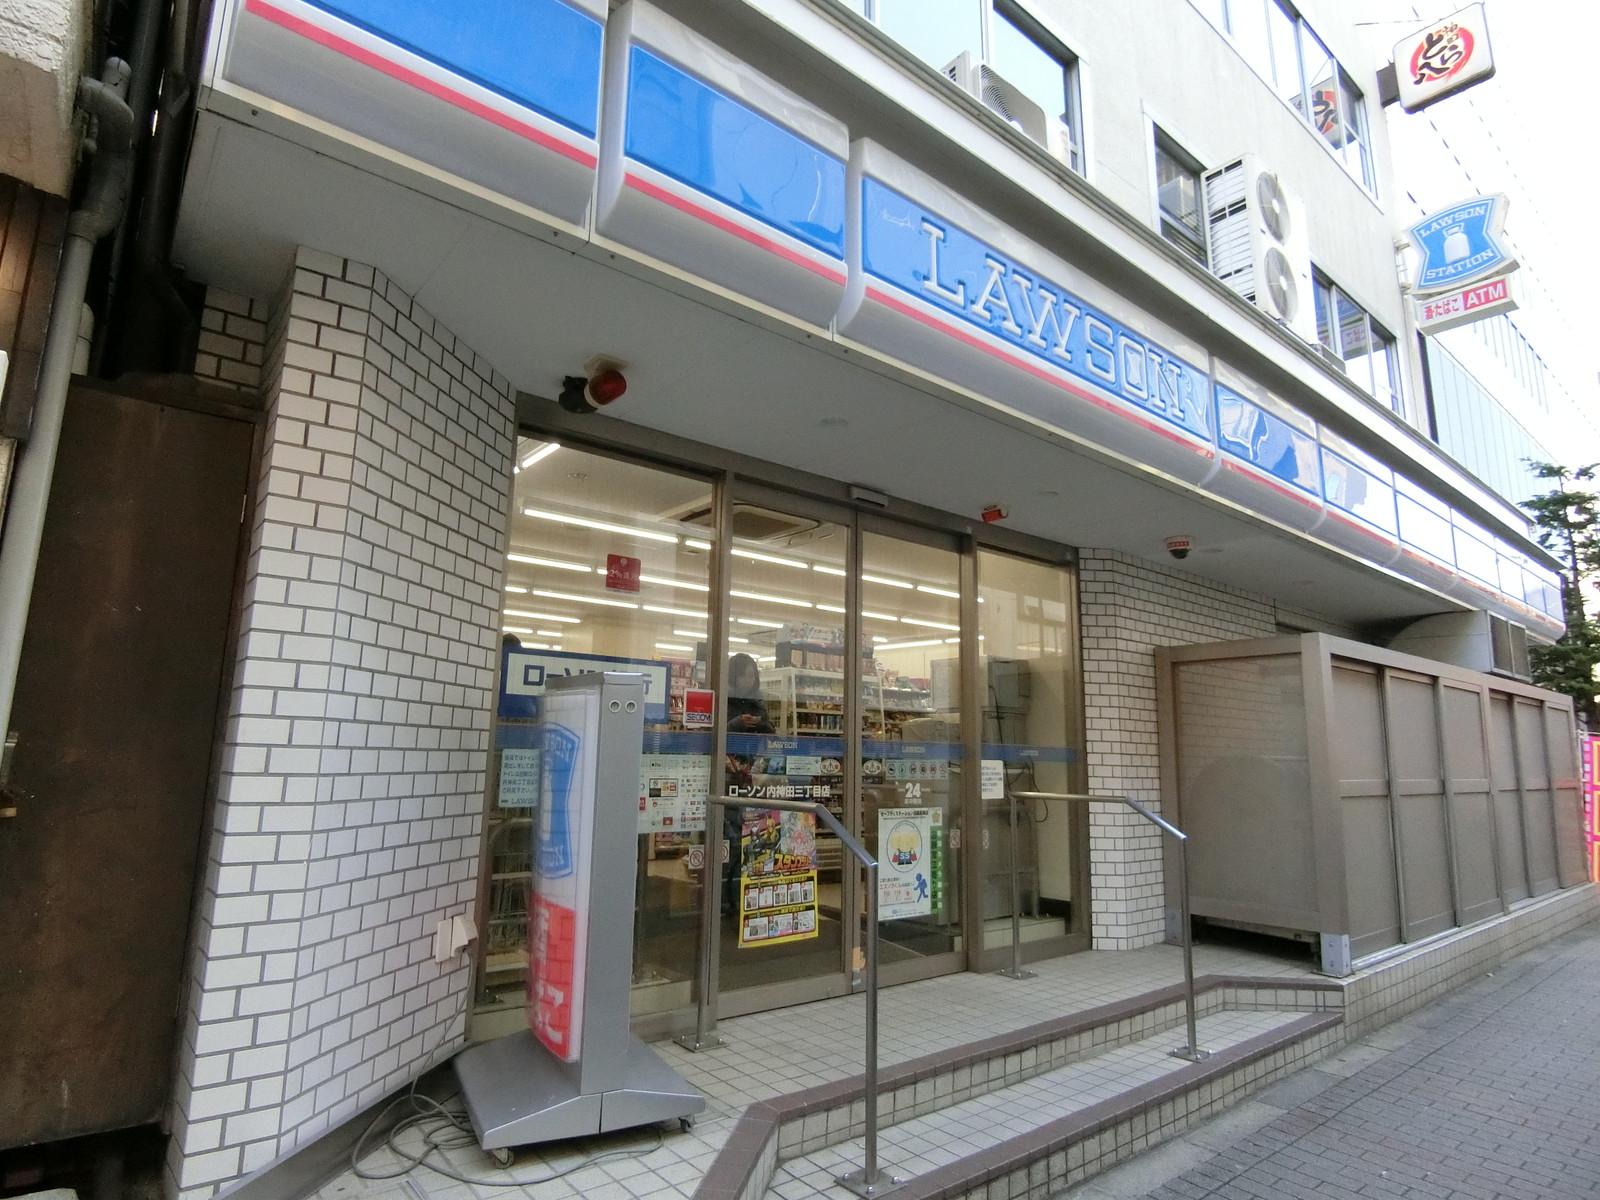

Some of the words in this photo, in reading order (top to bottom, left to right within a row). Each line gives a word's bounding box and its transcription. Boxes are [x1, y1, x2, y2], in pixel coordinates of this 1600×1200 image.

[1418, 205, 1487, 239] LAWSON
[1426, 248, 1494, 280] STATION
[1466, 282, 1505, 308] ATM
[921, 219, 1186, 421] LAWSON
[686, 713, 711, 722] SECOM
[767, 740, 798, 749] LAWSON
[728, 785, 831, 798] ローソン内神田三丁目店
[904, 782, 922, 798] 24
[899, 852, 911, 860] SS
